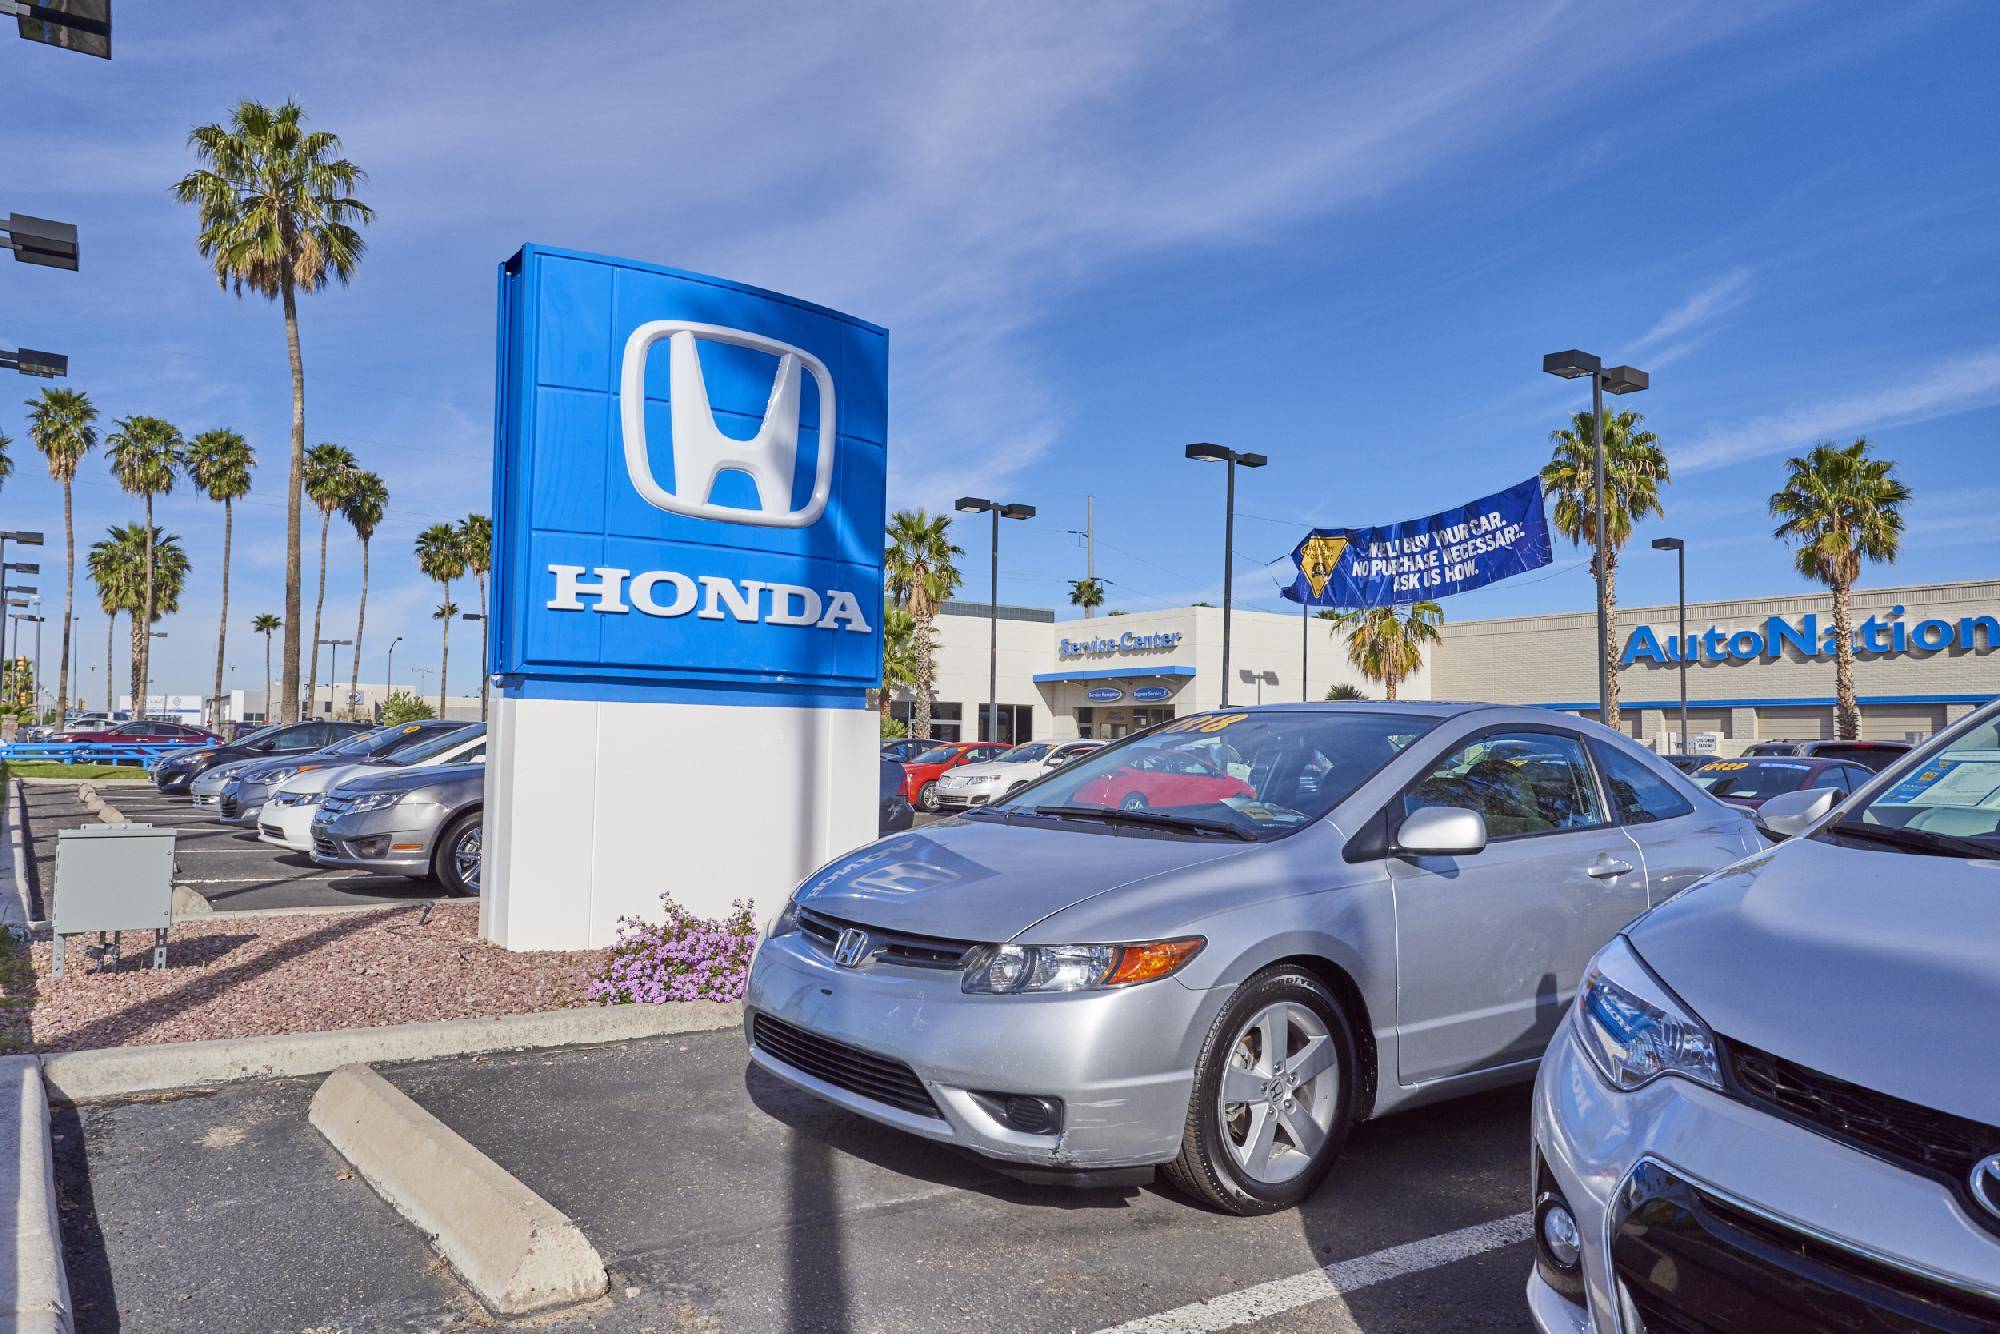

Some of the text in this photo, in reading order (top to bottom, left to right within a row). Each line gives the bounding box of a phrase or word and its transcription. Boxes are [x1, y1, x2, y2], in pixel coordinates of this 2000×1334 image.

[1403, 533, 1430, 553] BUY
[1432, 523, 1469, 547] YOUR
[1470, 511, 1507, 536] CAR.
[1351, 561, 1369, 577] NO
[1371, 550, 1440, 576] PURCHASE
[1393, 559, 1480, 593] ASK US HOW.
[546, 563, 873, 633] HONDA
[1059, 630, 1182, 657] Service Center
[1622, 603, 2000, 666] AutoNation
